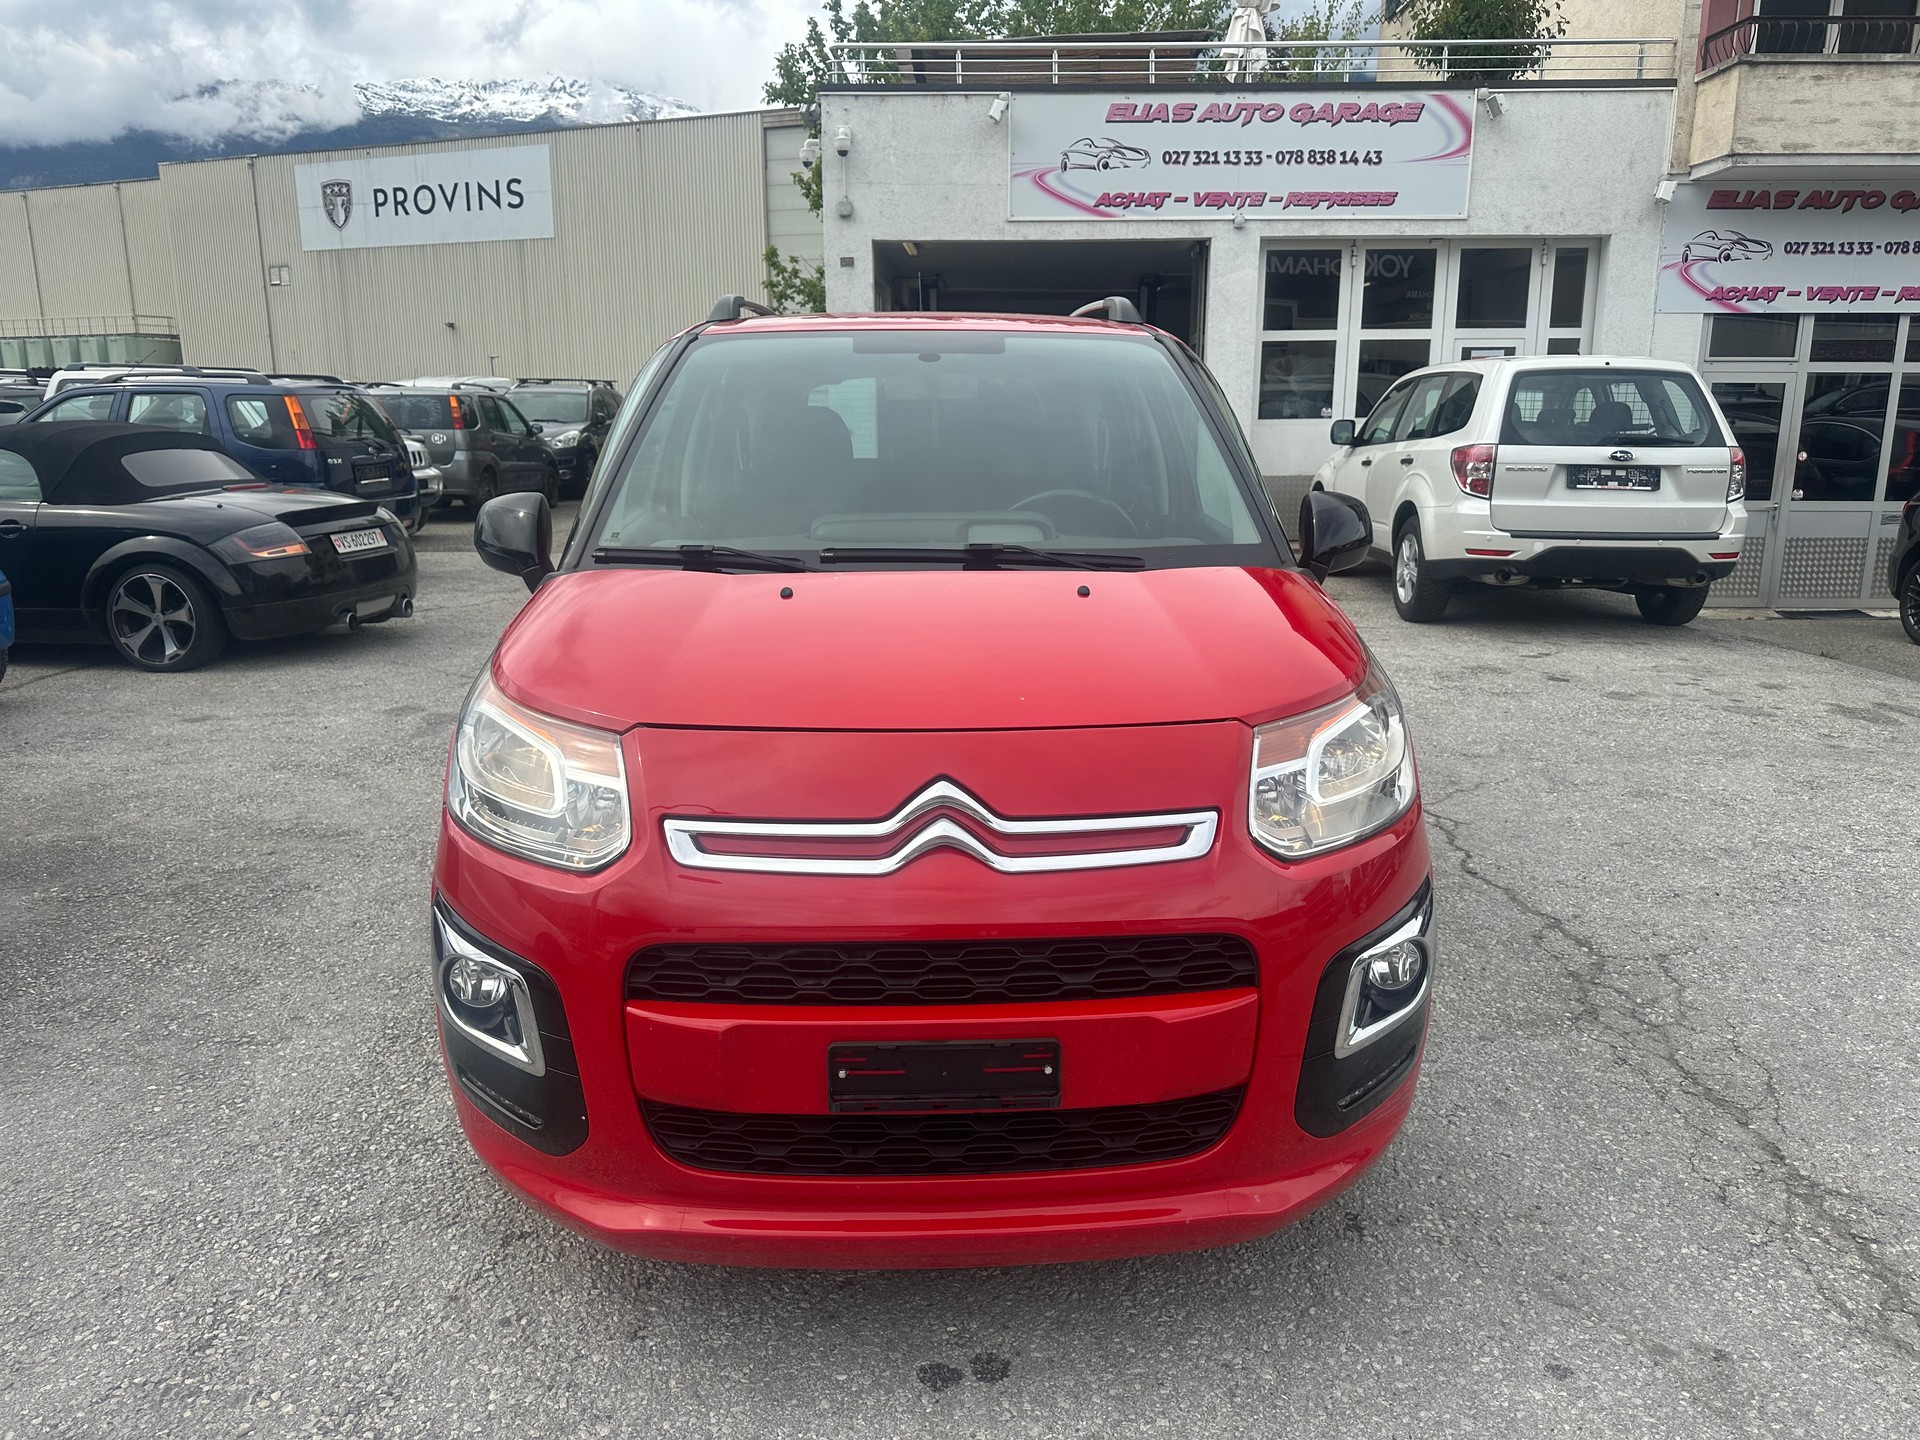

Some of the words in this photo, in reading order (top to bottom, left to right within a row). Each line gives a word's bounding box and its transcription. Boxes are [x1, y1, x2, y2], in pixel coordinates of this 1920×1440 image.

[1105, 103, 1198, 123] ELIAS
[1196, 102, 1285, 128] AUTO
[1289, 102, 1425, 128] GARAGE
[1162, 150, 1190, 166] 027
[1192, 150, 1220, 166] 321
[1223, 150, 1242, 166] 13
[1244, 150, 1263, 166] 33
[1275, 149, 1304, 166] 078
[1307, 149, 1336, 166] 838
[1339, 150, 1359, 166] 14
[1362, 150, 1383, 166] 43
[372, 177, 525, 218] PROVINS
[1093, 192, 1172, 211] ACHAT
[1193, 192, 1267, 211] VENTE
[1282, 191, 1399, 210] REPRISES
[1706, 190, 1799, 210] ELIAS
[1797, 190, 1887, 214] AUTO
[1784, 241, 1810, 255] 027
[1810, 241, 1835, 255] 321
[1838, 241, 1855, 255] 13
[1856, 241, 1874, 255] 33
[1884, 240, 1910, 255] 078
[1705, 286, 1785, 304] ACHAT
[1806, 286, 1880, 304] VENTE
